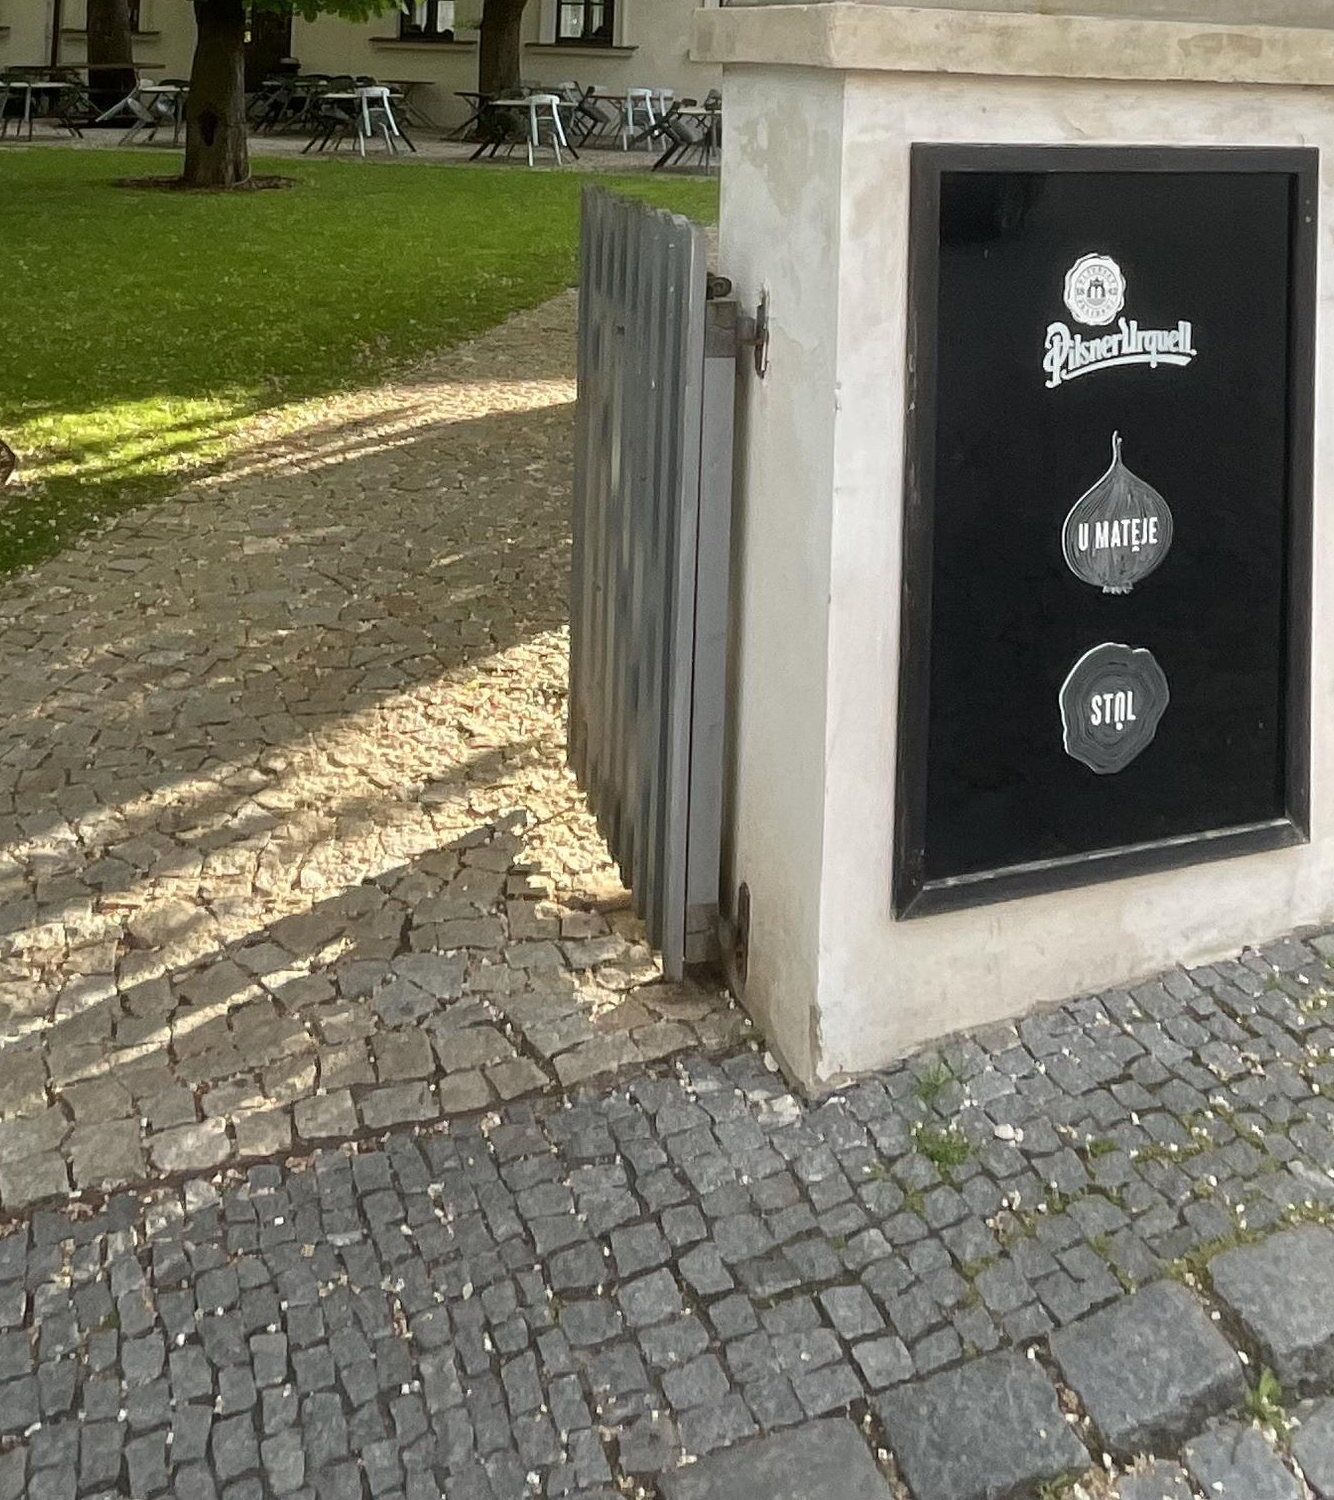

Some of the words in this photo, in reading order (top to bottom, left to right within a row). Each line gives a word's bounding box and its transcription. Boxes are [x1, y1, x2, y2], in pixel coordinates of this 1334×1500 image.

[1043, 321, 1123, 388] Pilsner
[1118, 316, 1197, 368] Urquell
[1078, 522, 1089, 552] U
